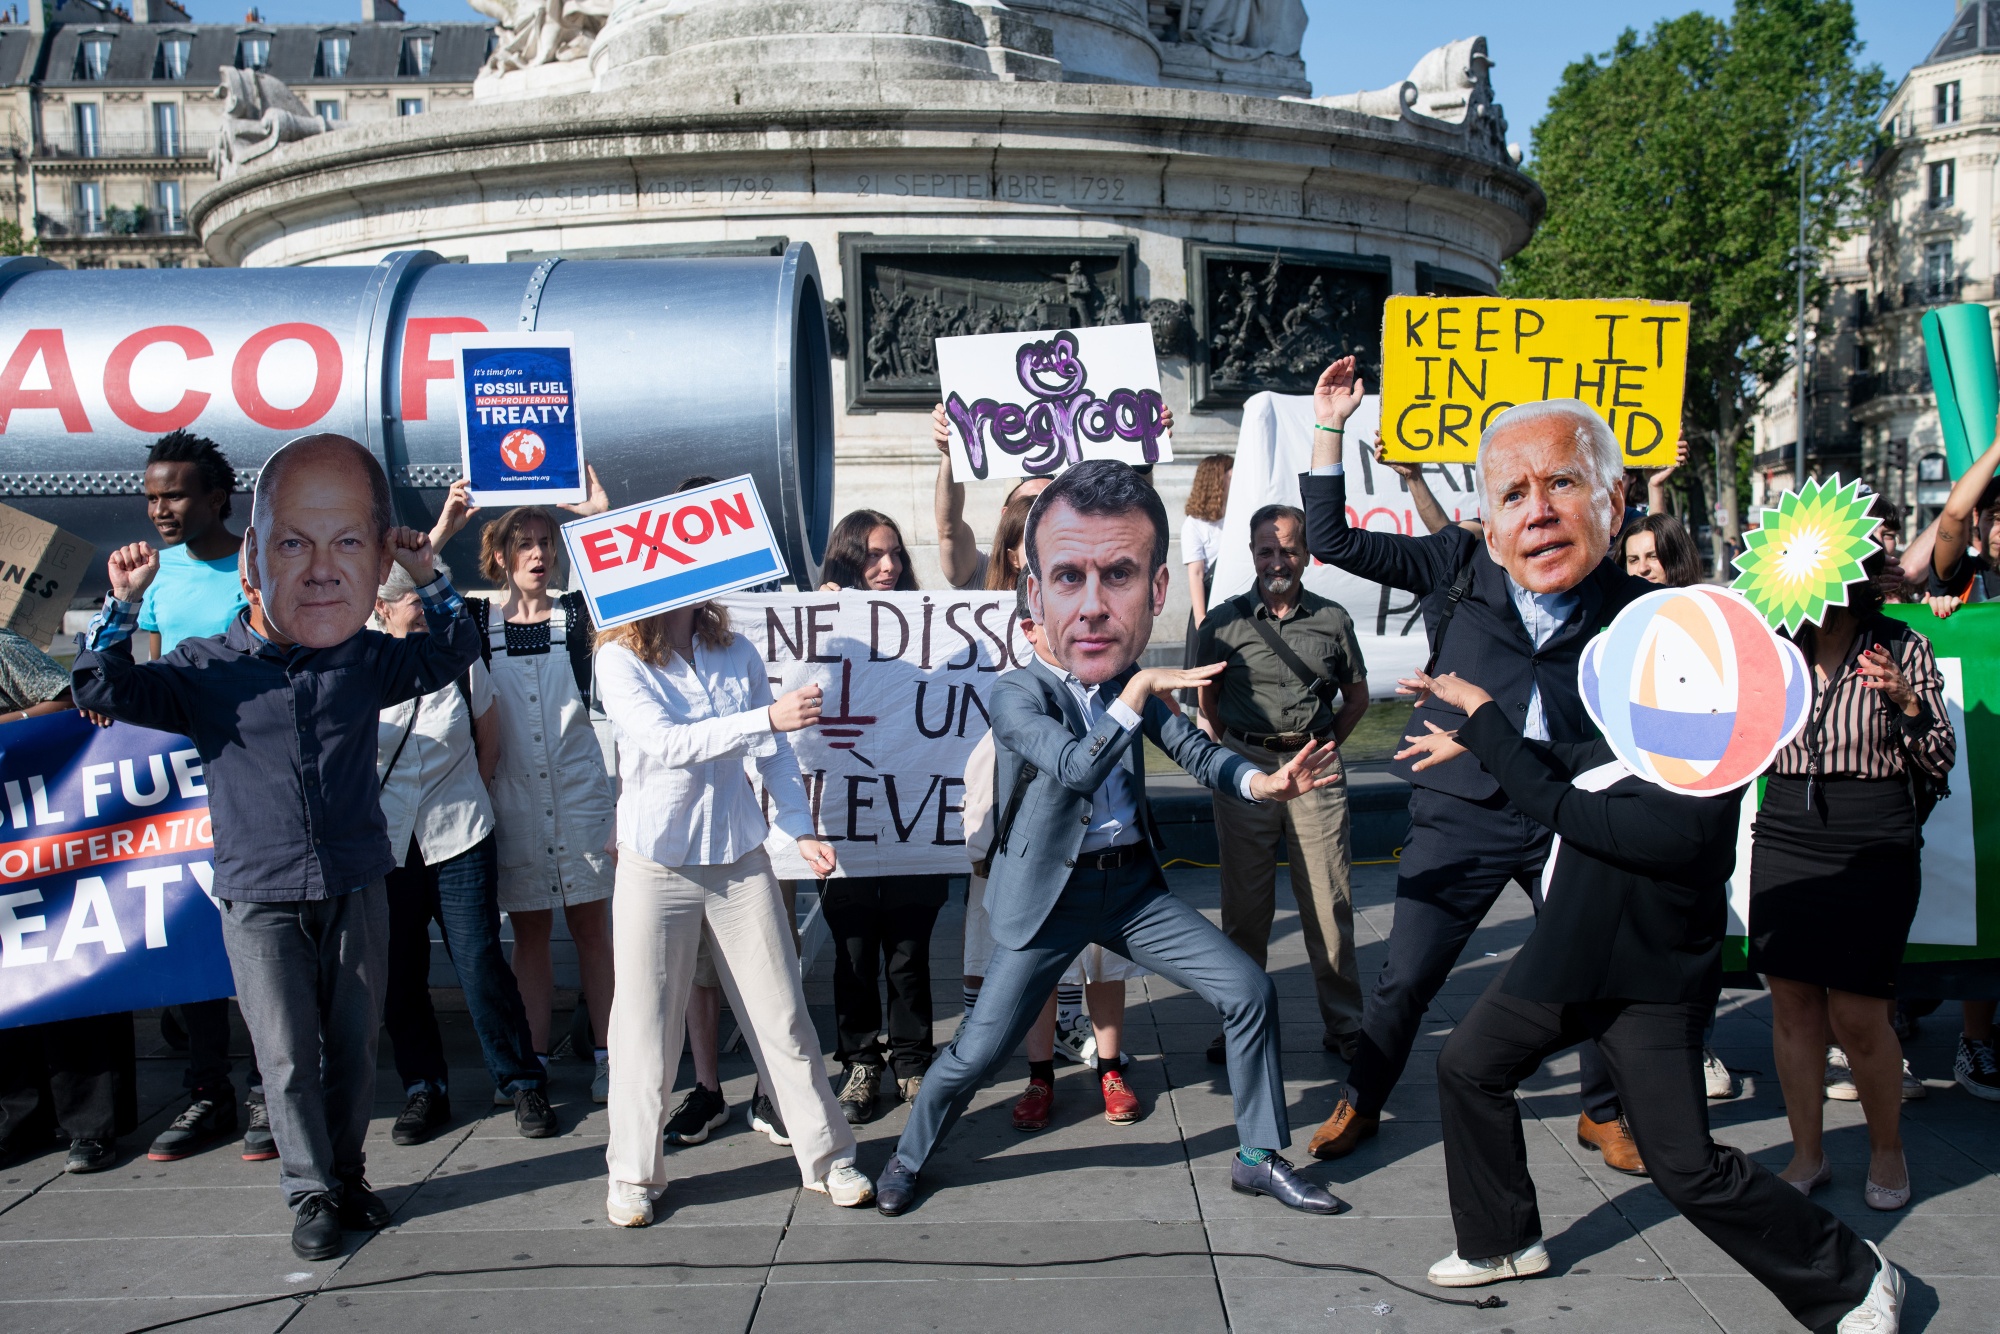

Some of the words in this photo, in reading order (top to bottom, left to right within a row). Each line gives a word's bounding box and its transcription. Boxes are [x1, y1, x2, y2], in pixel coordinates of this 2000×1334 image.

[515, 191, 544, 215] 20
[555, 179, 706, 211] SEPTEMBRE
[719, 177, 774, 202] 1792
[857, 174, 879, 198] 21
[895, 174, 1057, 199] SEPTEMBRE
[1072, 176, 1125, 201] 1792
[1213, 184, 1232, 206] 13
[391, 205, 428, 231] 1792
[1406, 307, 1545, 354] KEEP
[1593, 314, 1681, 369] IT
[487, 368, 503, 376] time
[504, 367, 516, 377] for
[1414, 356, 1487, 401] IN
[1528, 357, 1647, 408] THE
[477, 396, 567, 405] NON-PROLIFERATION
[530, 382, 569, 394] FUEL
[476, 406, 569, 425] TREATY
[580, 492, 755, 573] EXXON
